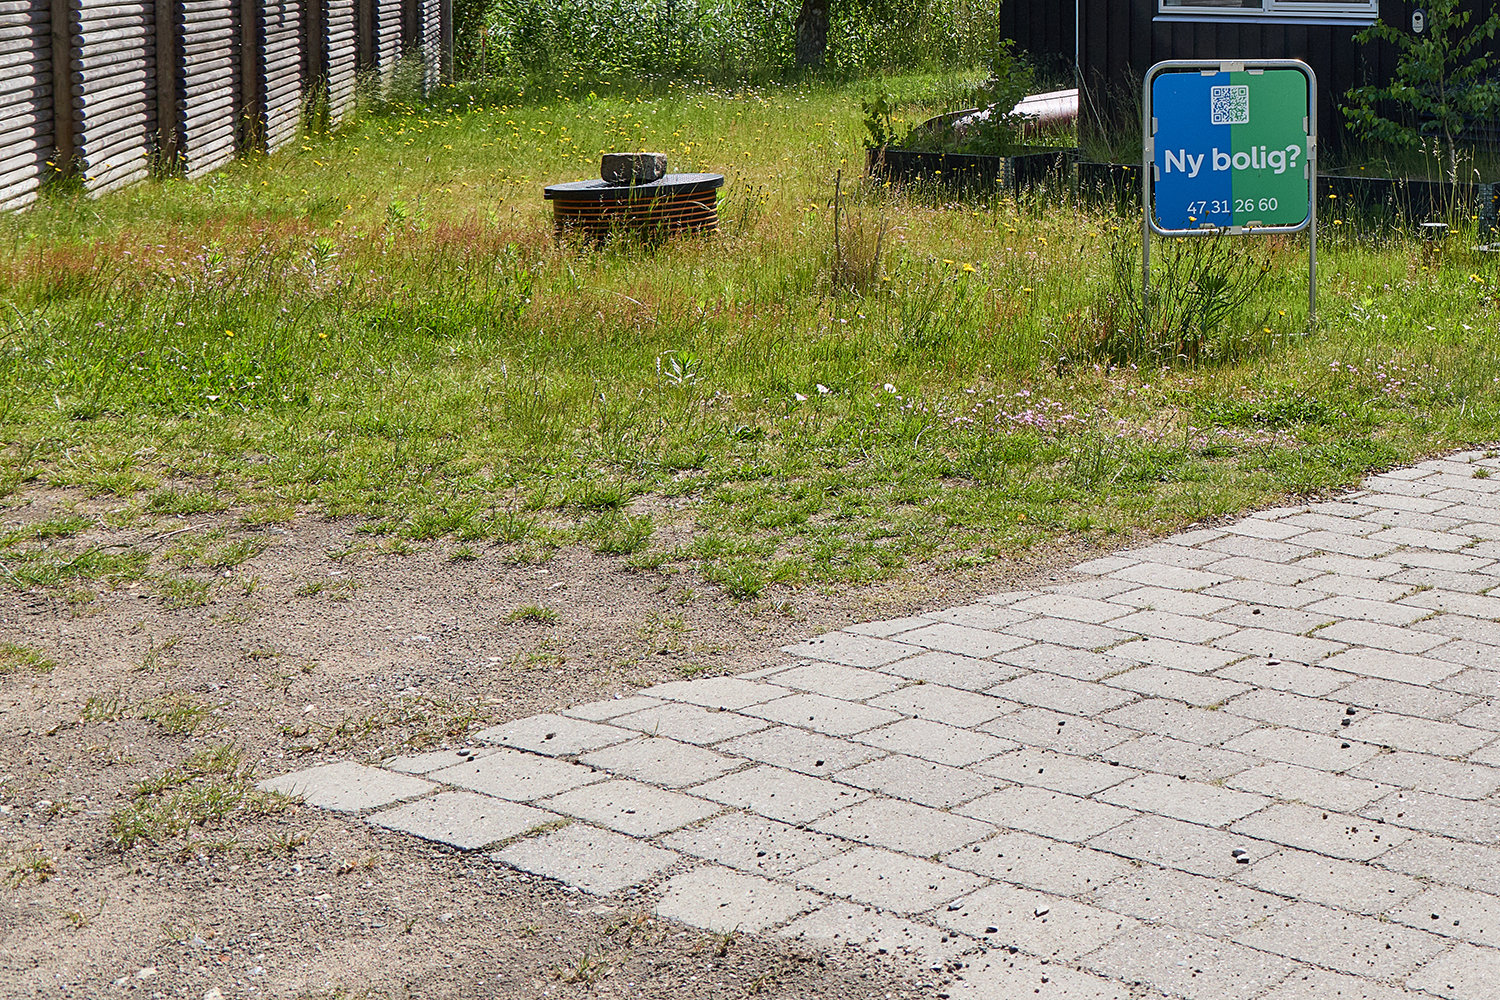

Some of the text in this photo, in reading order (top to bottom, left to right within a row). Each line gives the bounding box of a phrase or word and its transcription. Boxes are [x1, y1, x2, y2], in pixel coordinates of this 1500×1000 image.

[1164, 144, 1301, 178] Ny bolig?
[1187, 197, 1278, 215] 47 31 26 60
